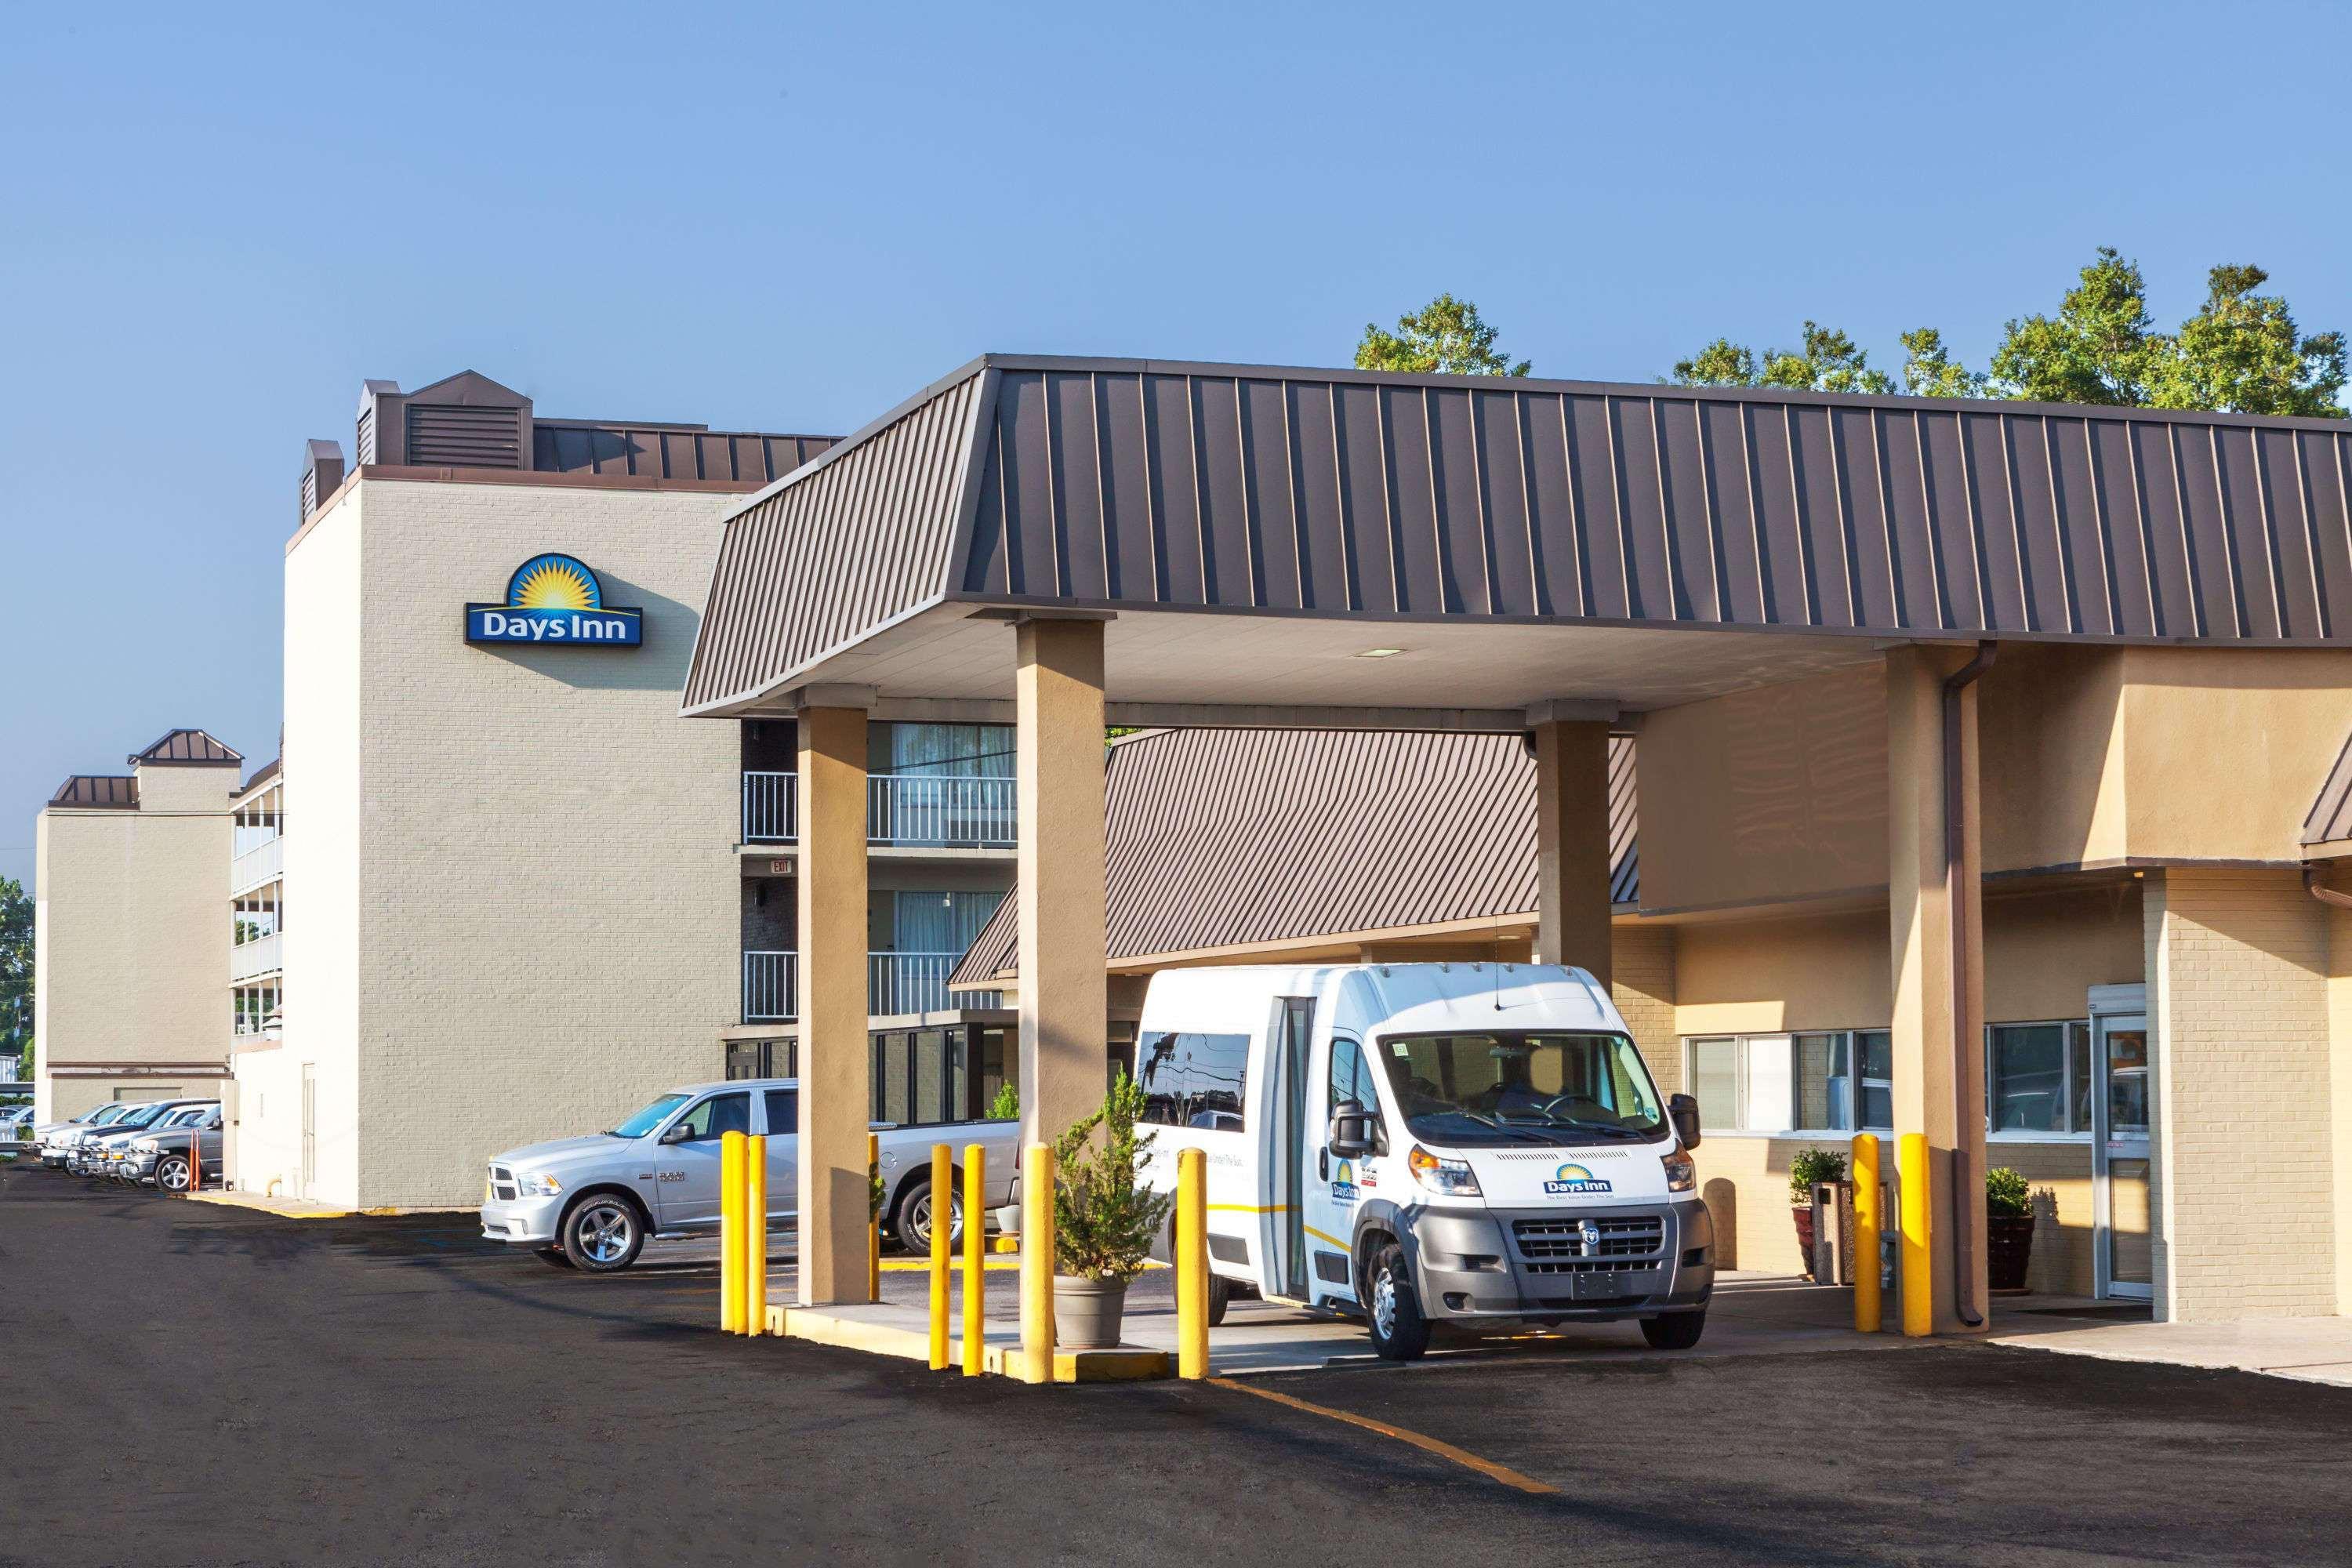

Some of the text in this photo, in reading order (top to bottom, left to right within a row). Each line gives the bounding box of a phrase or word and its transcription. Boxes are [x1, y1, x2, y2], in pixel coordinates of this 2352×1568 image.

[484, 612, 626, 641] Days Inn
[774, 861, 789, 873] EXIT
[1333, 1184, 1360, 1198] Days Inn
[1548, 1181, 1610, 1192] Days Inn
